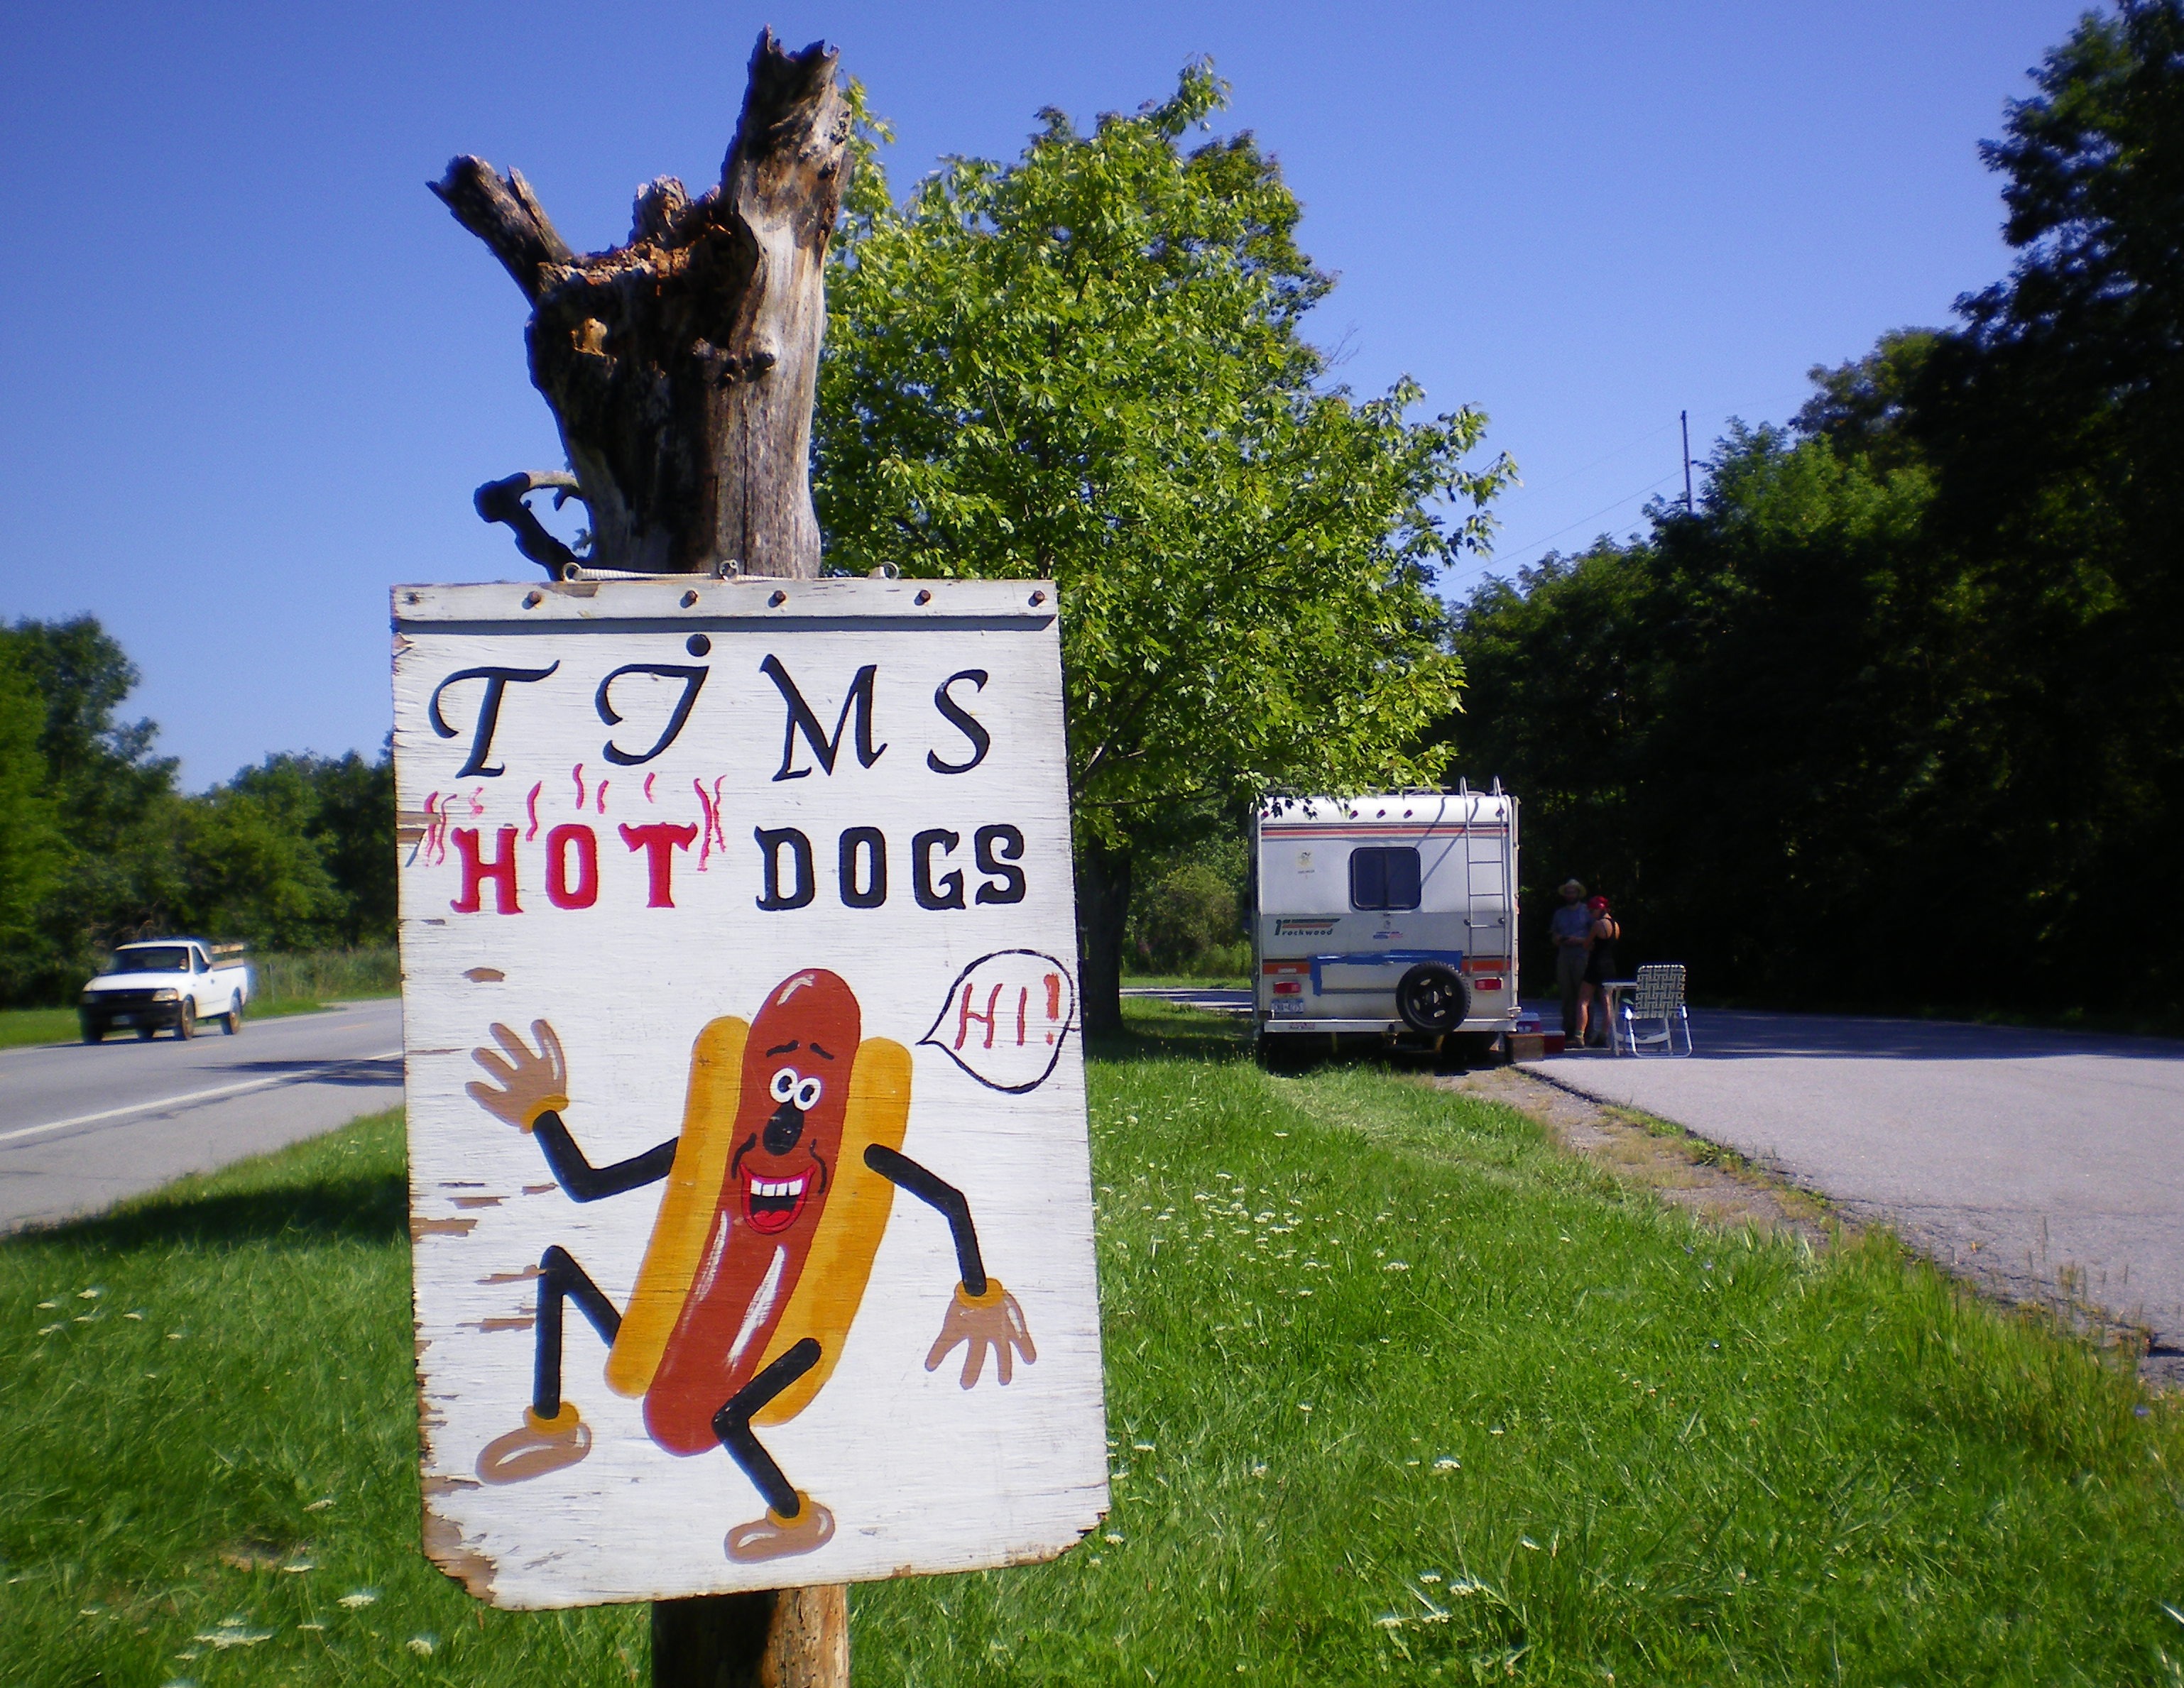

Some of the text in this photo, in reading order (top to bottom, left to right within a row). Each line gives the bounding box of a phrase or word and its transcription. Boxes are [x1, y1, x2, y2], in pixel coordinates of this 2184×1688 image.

[449, 823, 1026, 915] HOT DOGS
[1282, 928, 1333, 936] rockwood
[954, 972, 1060, 1051] HI!
